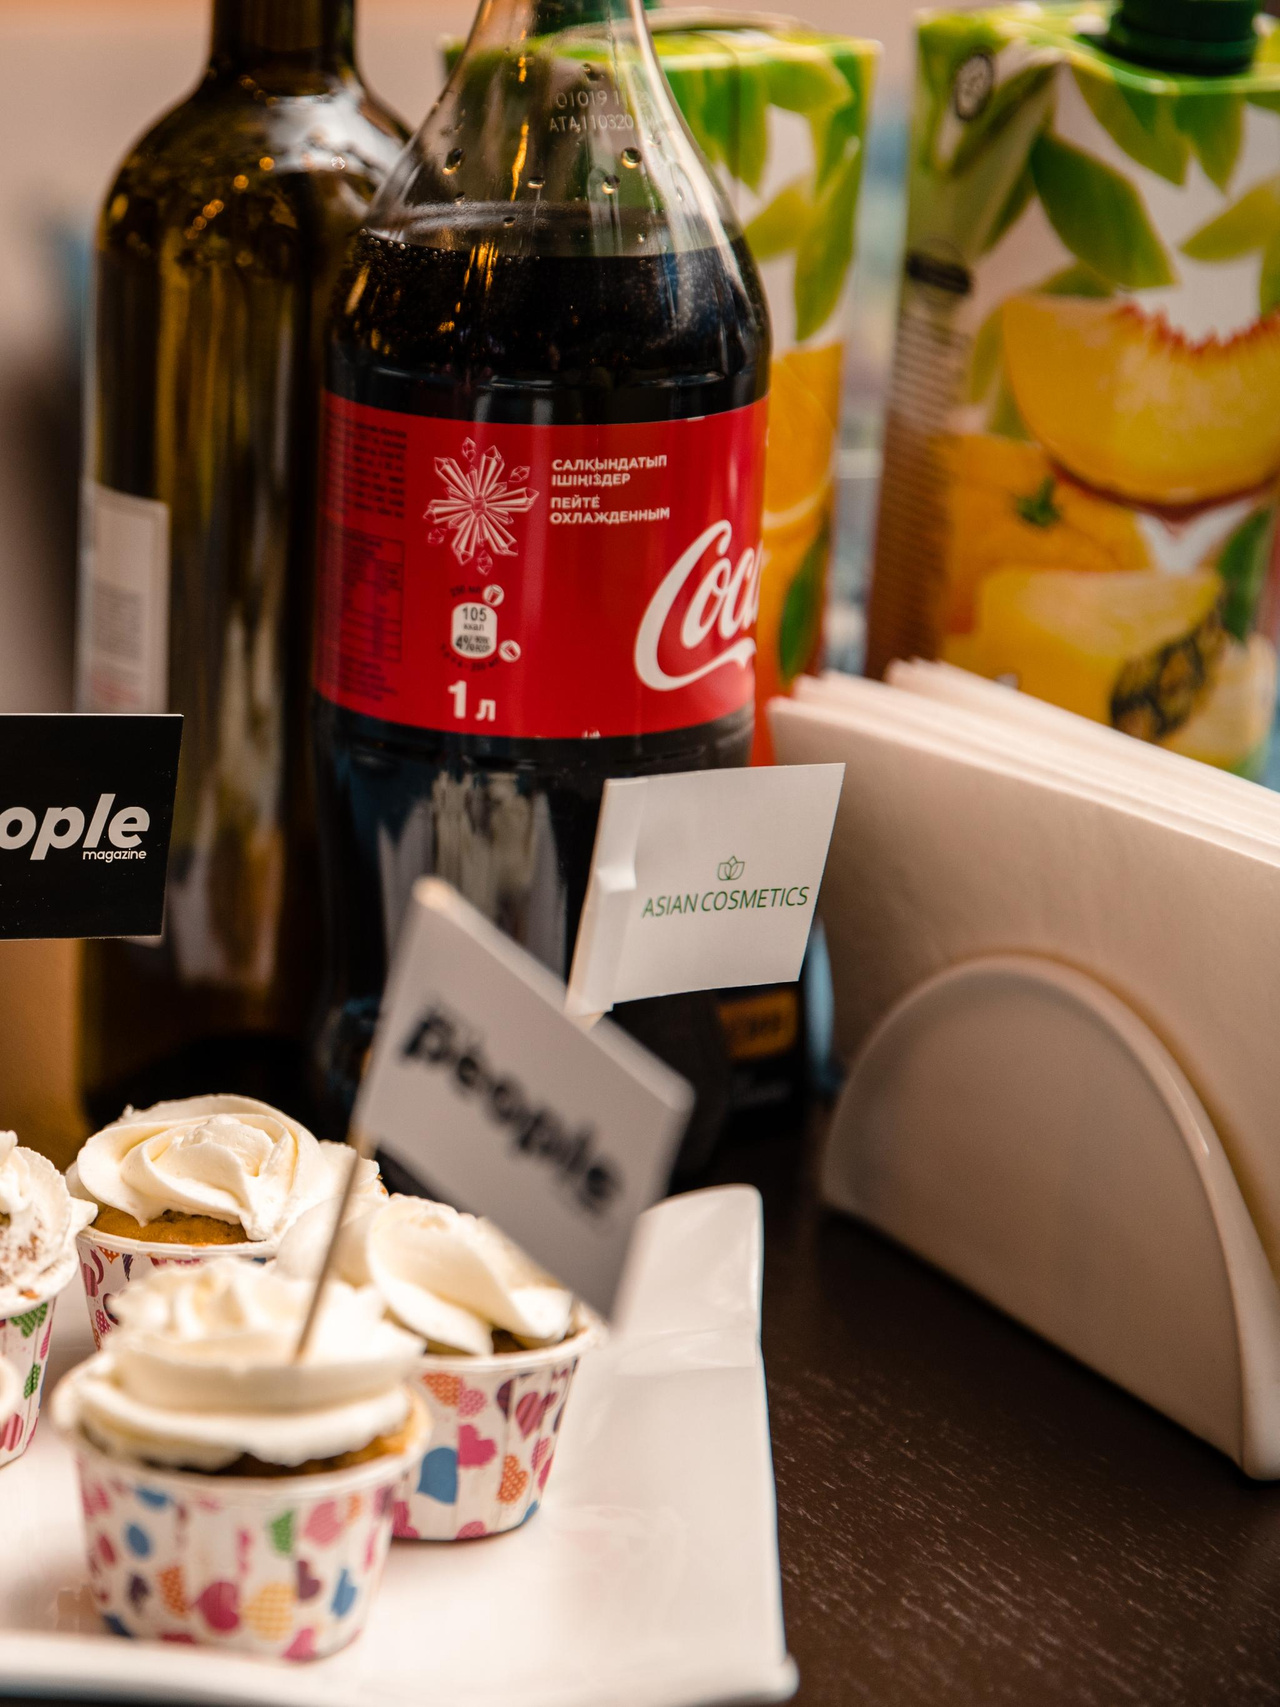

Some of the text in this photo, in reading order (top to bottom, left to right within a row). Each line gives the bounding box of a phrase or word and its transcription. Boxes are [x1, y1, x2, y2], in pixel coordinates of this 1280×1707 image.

[550, 507, 670, 525] ОХЛАЖДЕННЫМ
[462, 606, 487, 622] 105
[448, 680, 467, 719] 1
[82, 848, 147, 863] magazine
[642, 886, 810, 918] ASIAN COSMETICS
